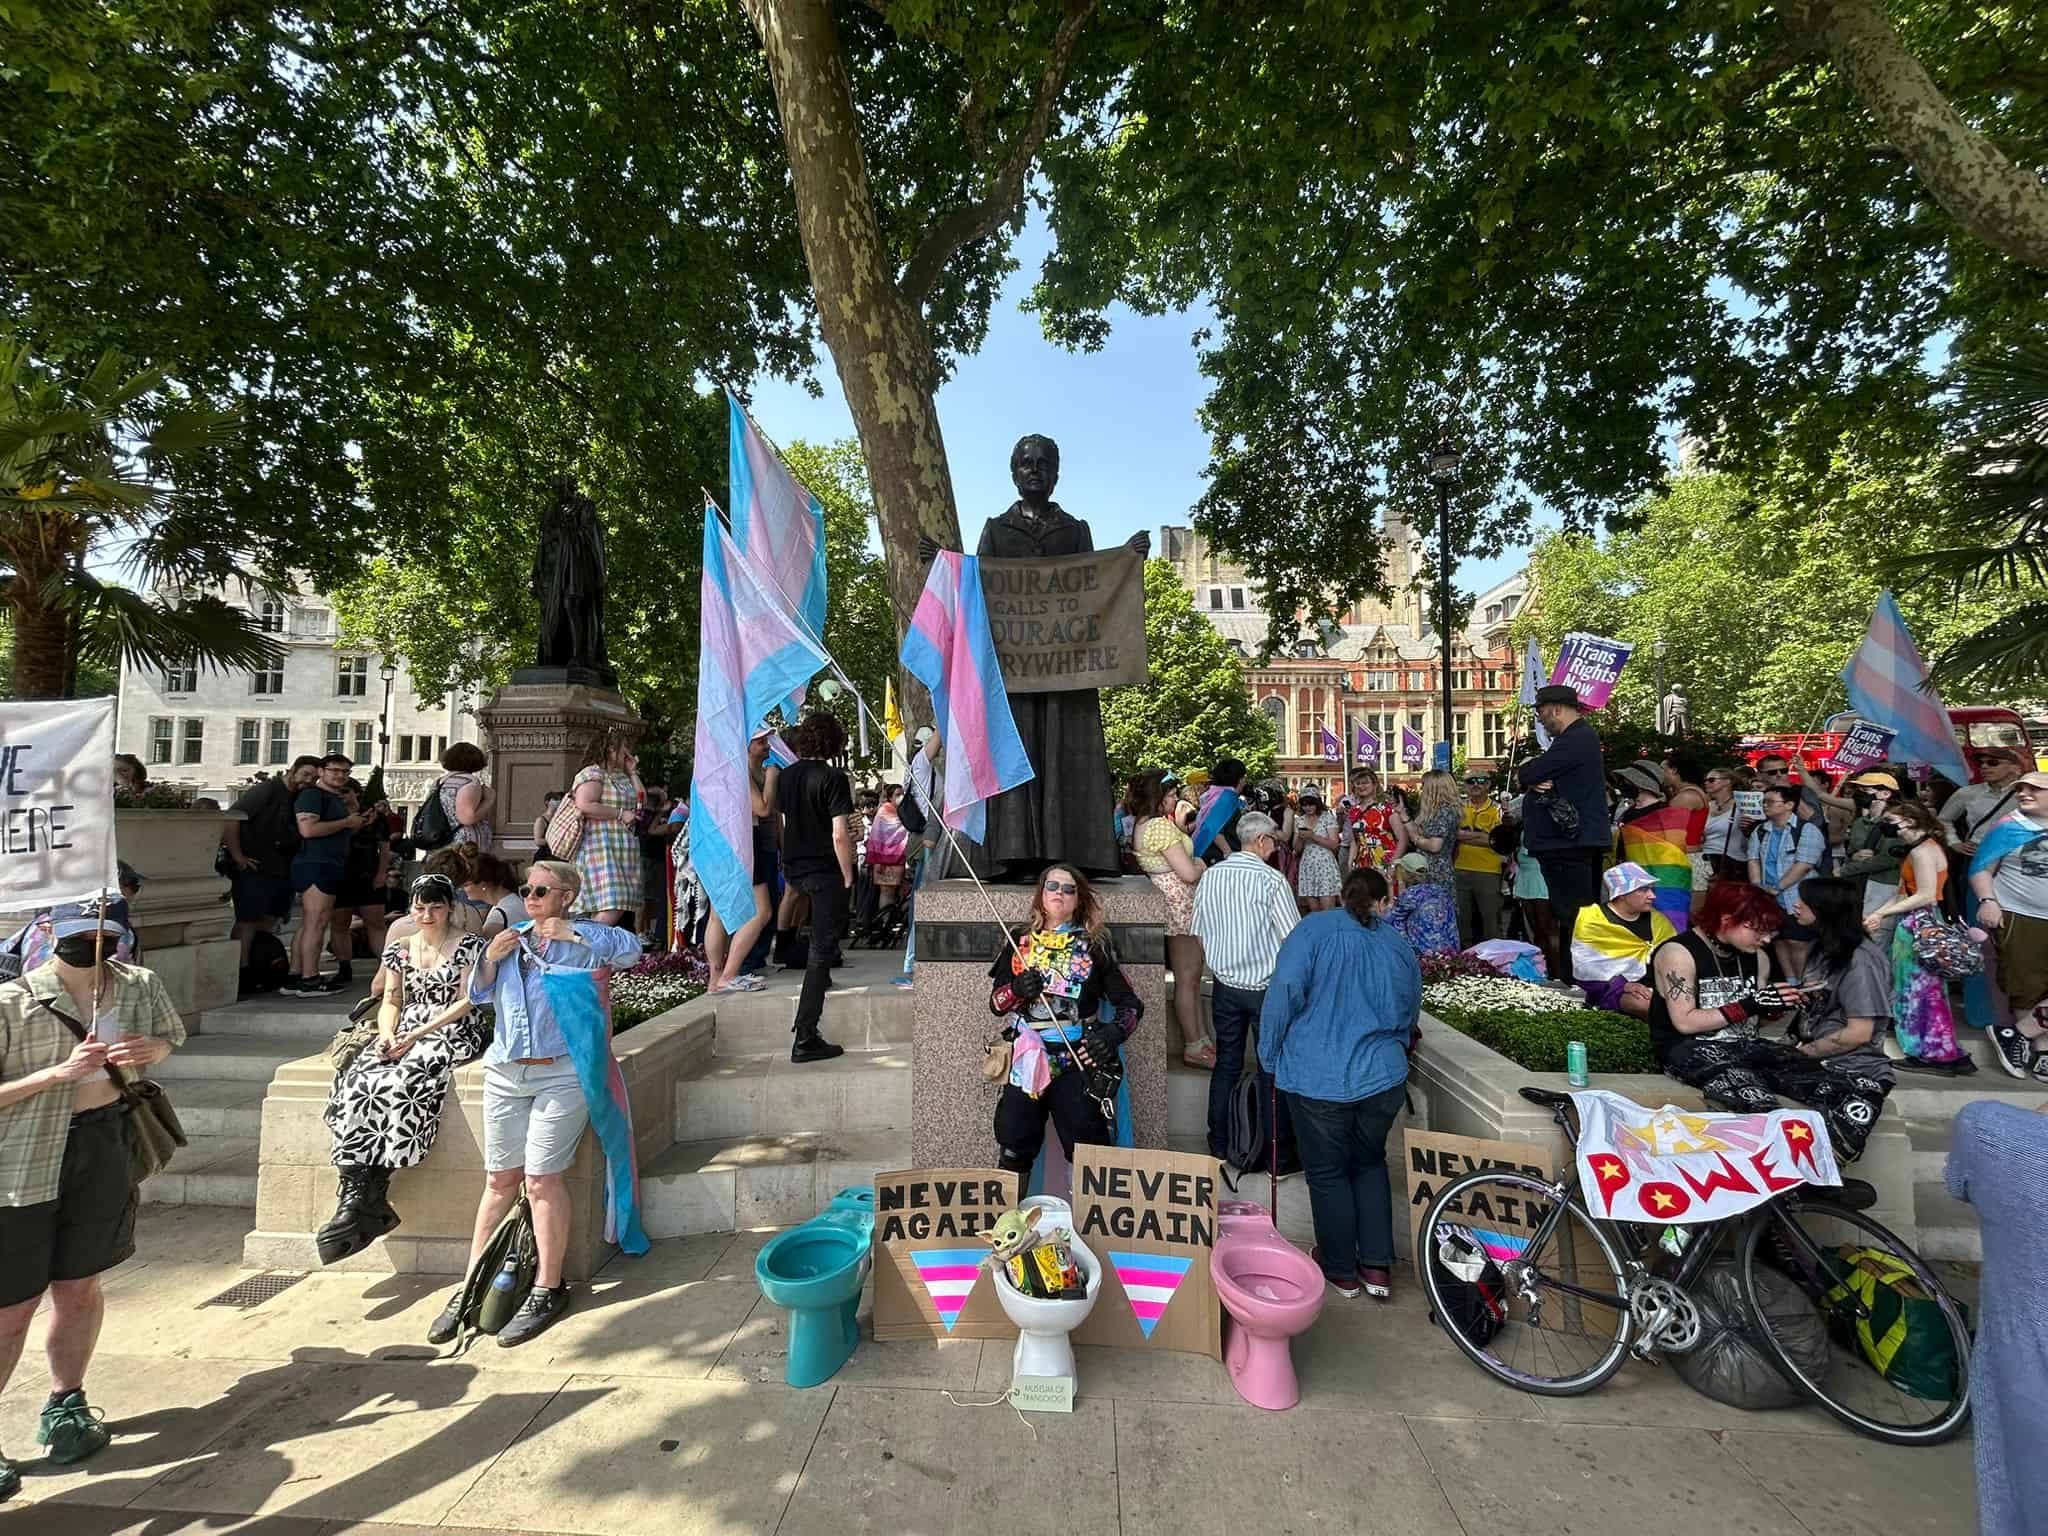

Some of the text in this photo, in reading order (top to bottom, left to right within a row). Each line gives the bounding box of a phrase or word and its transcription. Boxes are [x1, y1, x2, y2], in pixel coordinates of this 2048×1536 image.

[986, 565, 1098, 595] OURAGE
[993, 598, 1079, 616] CALLS TO
[991, 614, 1100, 646] OURAGE
[1001, 645, 1119, 677] RYWHERE
[1577, 639, 1617, 665] Trans
[1569, 656, 1617, 684] Rights
[1563, 673, 1595, 697] Now
[1842, 738, 1883, 758] Rights
[1850, 725, 1883, 744] Trans
[1834, 750, 1863, 766] Now
[1587, 1119, 1821, 1218] POWER
[880, 1181, 1007, 1211] NEVER
[1082, 1165, 1214, 1210] NEVER
[1081, 1204, 1213, 1249] AGAIN
